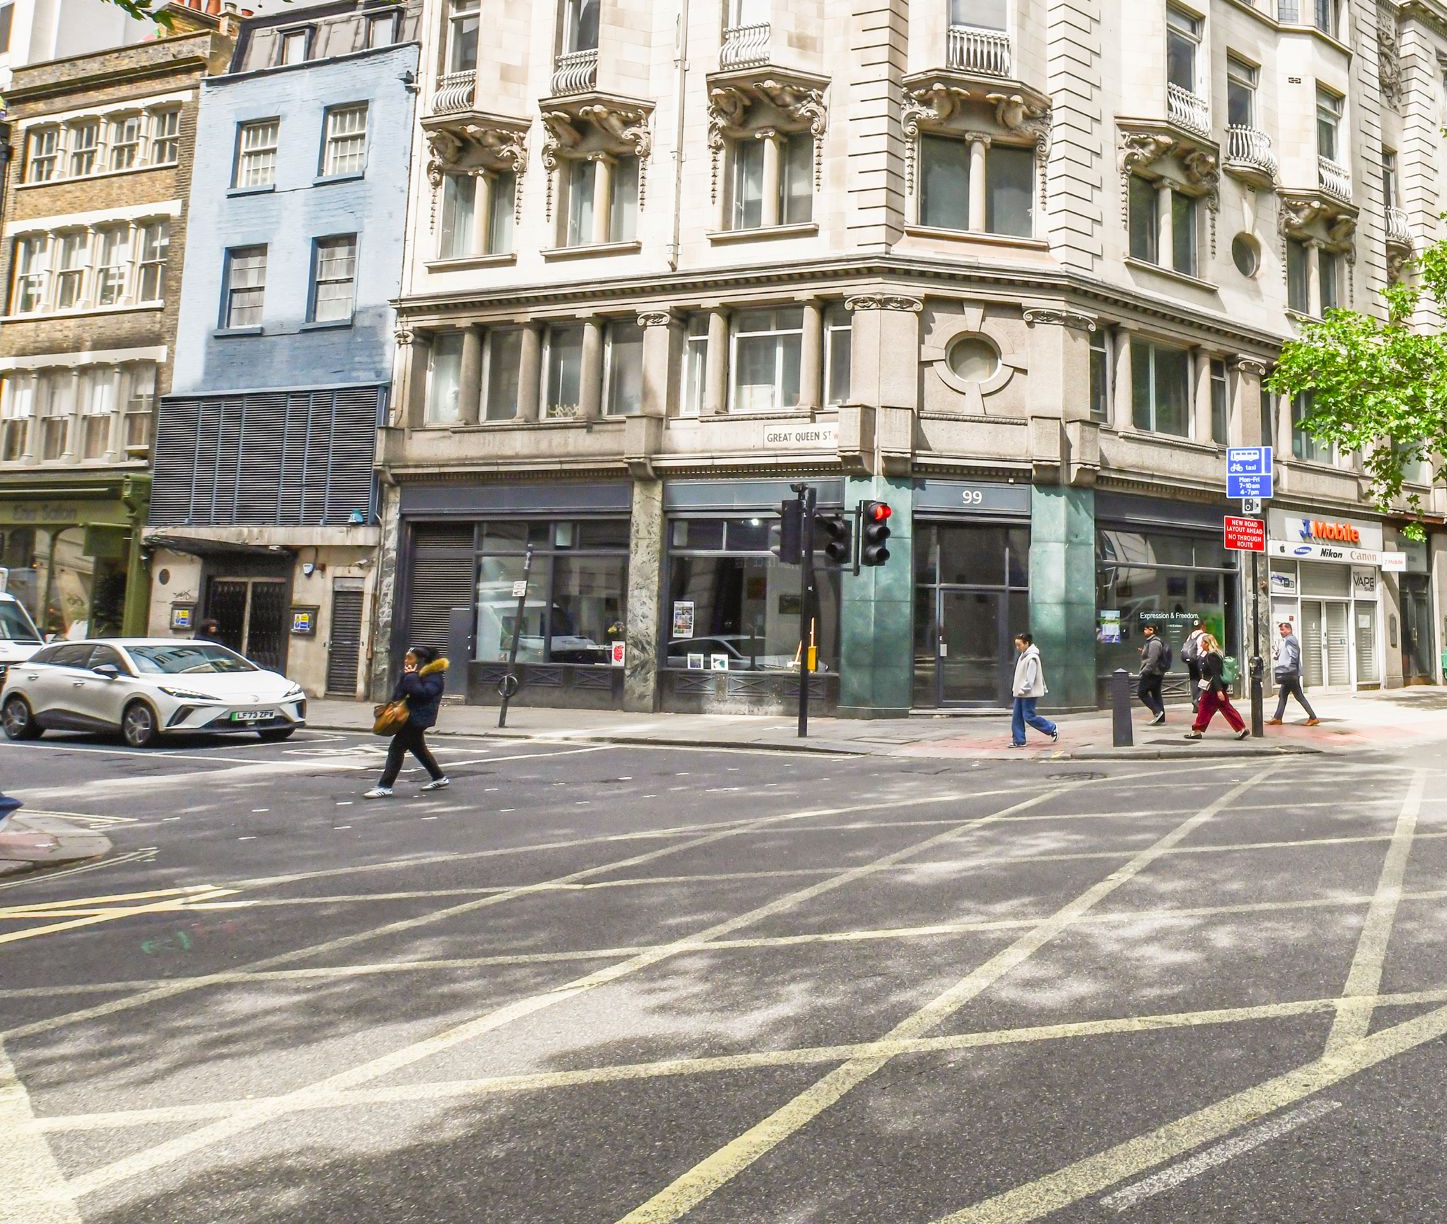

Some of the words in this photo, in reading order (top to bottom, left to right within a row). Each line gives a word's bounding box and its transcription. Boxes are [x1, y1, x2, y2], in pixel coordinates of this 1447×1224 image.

[767, 433, 792, 442] GREAT
[795, 432, 820, 442] QUEEN
[962, 490, 982, 504] 99
[1244, 520, 1259, 528] ROAD
[1226, 525, 1246, 533] LAYOUT
[1246, 527, 1263, 535] AHEAD
[1312, 519, 1360, 544] Mobile
[1237, 534, 1262, 543] THROUGH
[1320, 548, 1343, 559] Nikon
[1350, 550, 1377, 562] Canon
[1353, 575, 1375, 588] VAPE
